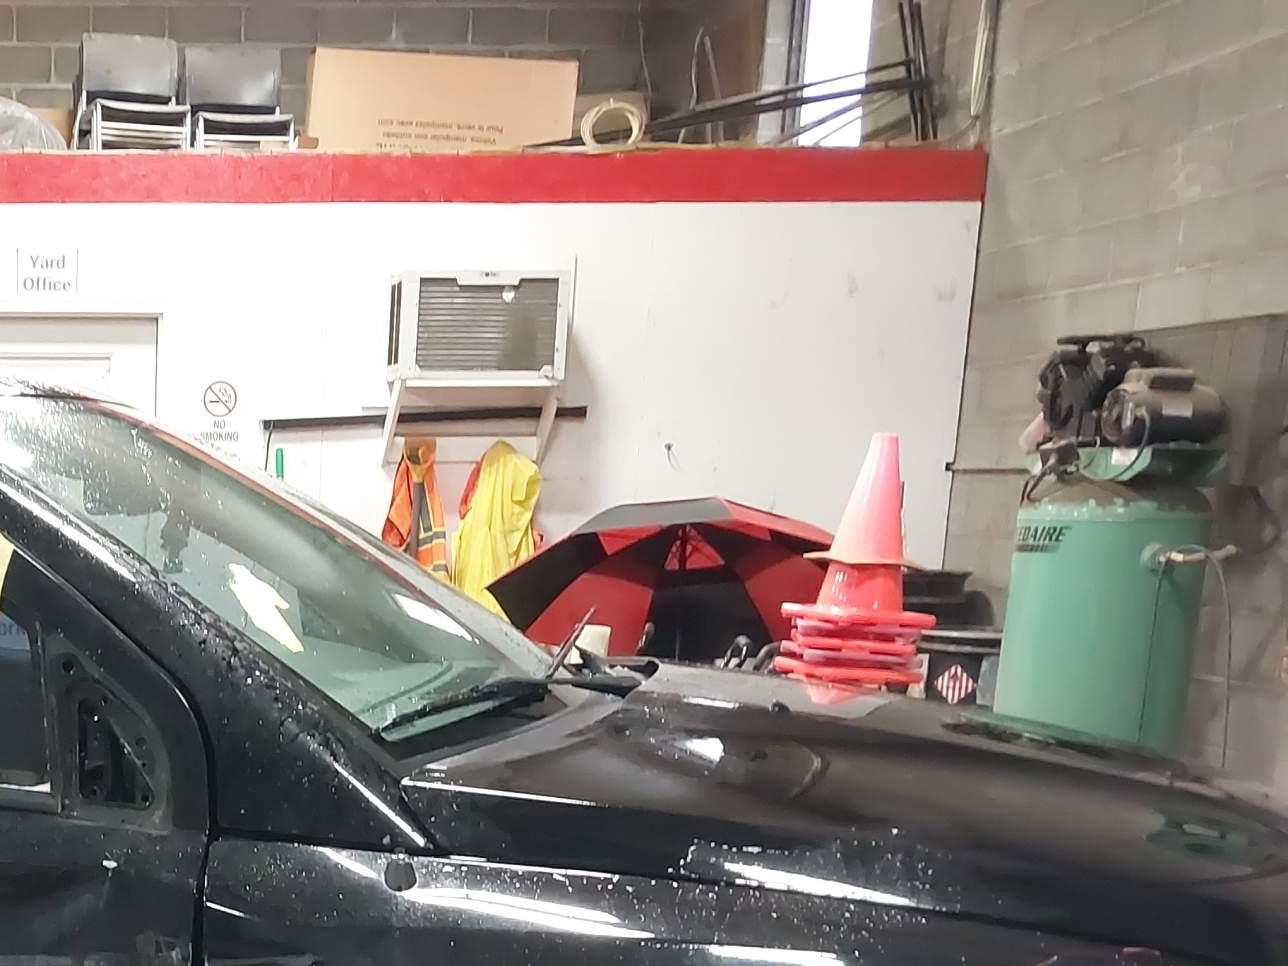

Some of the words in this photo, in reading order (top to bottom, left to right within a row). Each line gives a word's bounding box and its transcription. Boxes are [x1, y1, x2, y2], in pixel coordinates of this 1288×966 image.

[30, 254, 66, 270] Yard
[23, 276, 72, 292] Office
[213, 419, 226, 430] NO
